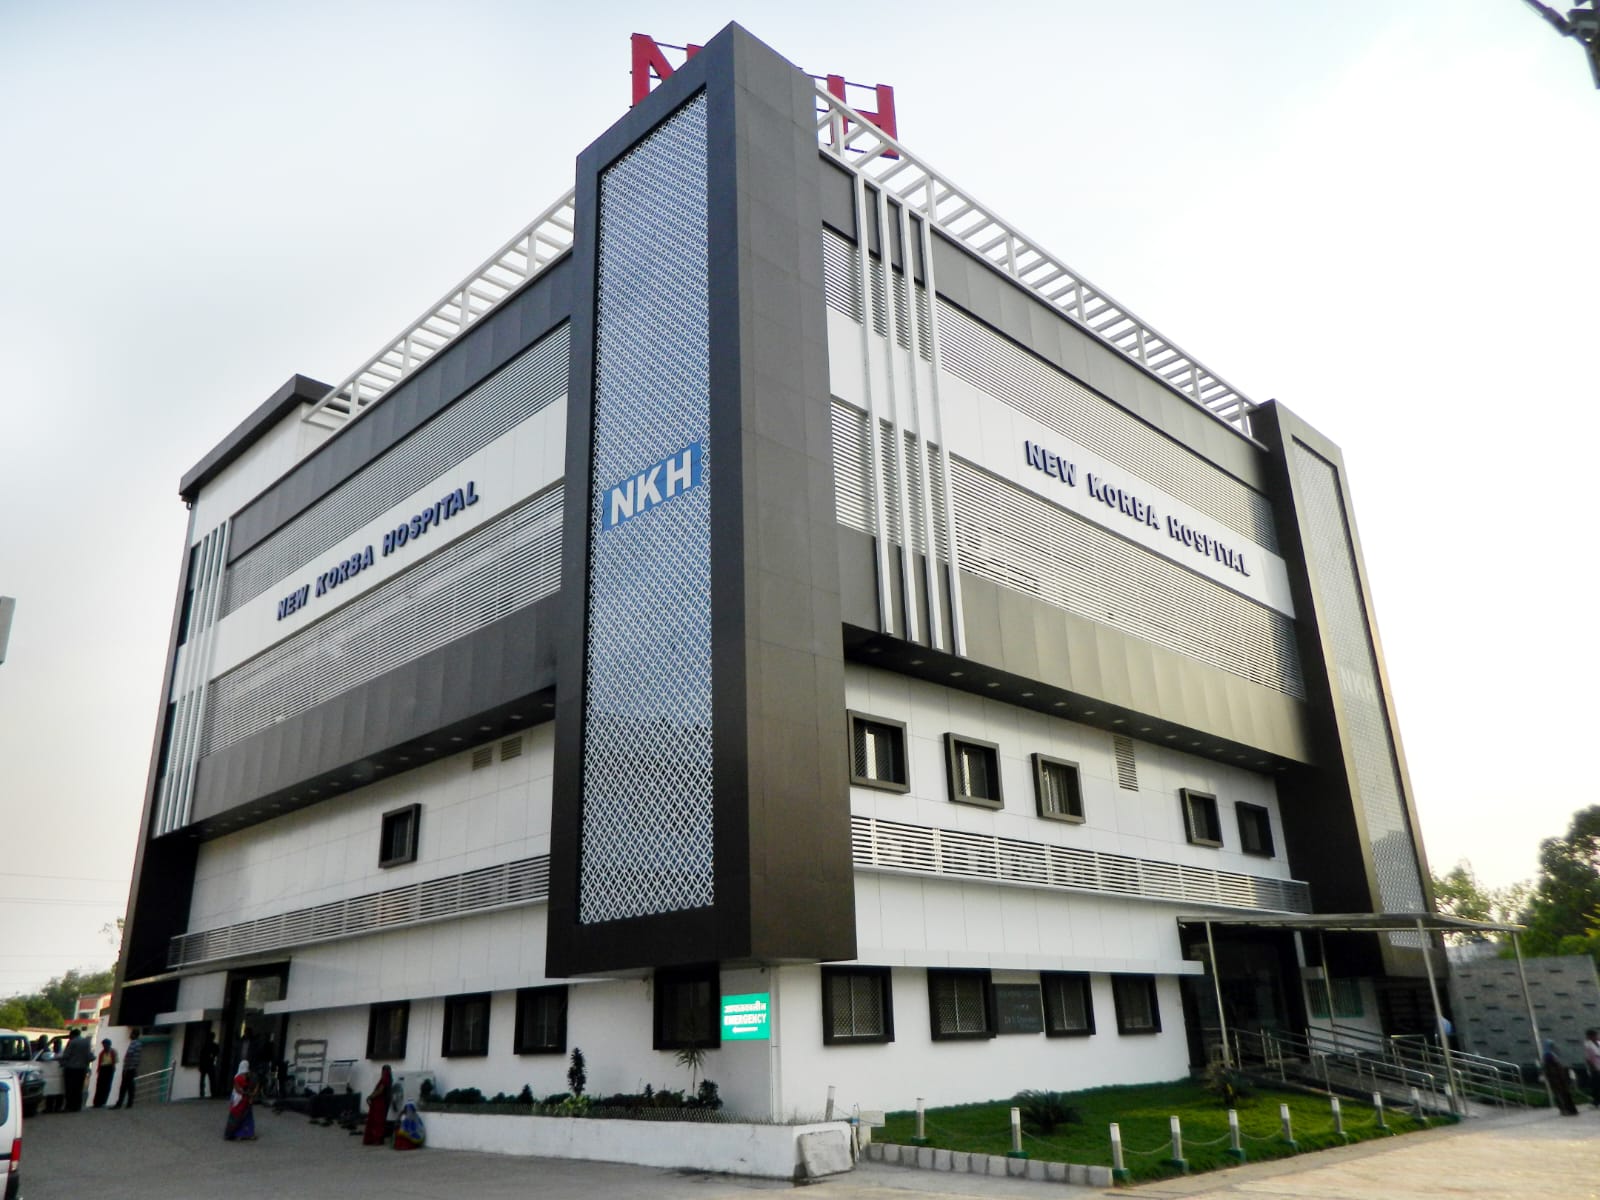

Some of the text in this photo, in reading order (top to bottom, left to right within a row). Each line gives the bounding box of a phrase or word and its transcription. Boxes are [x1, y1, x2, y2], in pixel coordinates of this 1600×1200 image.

[631, 32, 899, 160] NH
[277, 481, 479, 621] NEW KORBA HOSPITAL
[611, 449, 692, 526] NKH
[1024, 440, 1250, 577] NEW KORBA HOSPITAL
[1339, 666, 1377, 704] NKH
